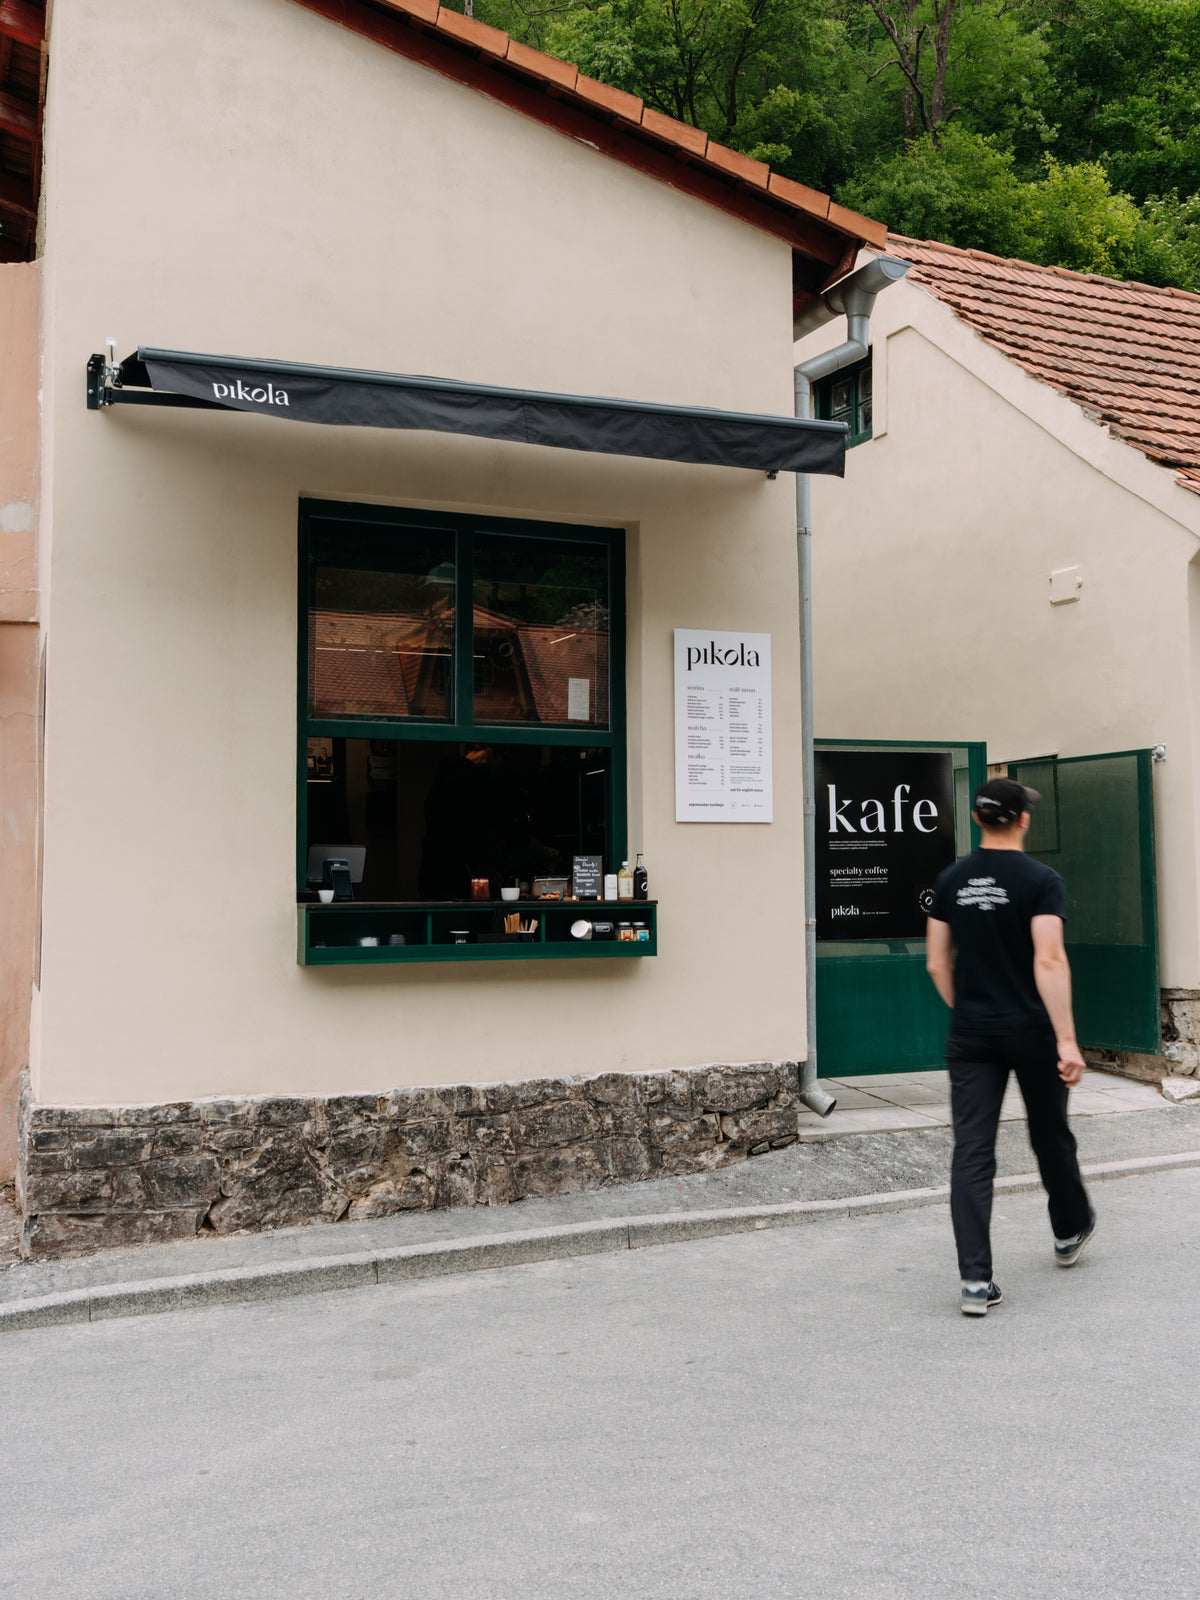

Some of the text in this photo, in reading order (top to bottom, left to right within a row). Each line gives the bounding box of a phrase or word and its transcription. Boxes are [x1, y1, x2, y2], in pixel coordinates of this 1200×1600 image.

[212, 379, 290, 406] pikola
[686, 641, 760, 671] pikola
[827, 783, 938, 833] kafe
[829, 866, 888, 877] specialty coffee
[831, 905, 860, 919] pikola
